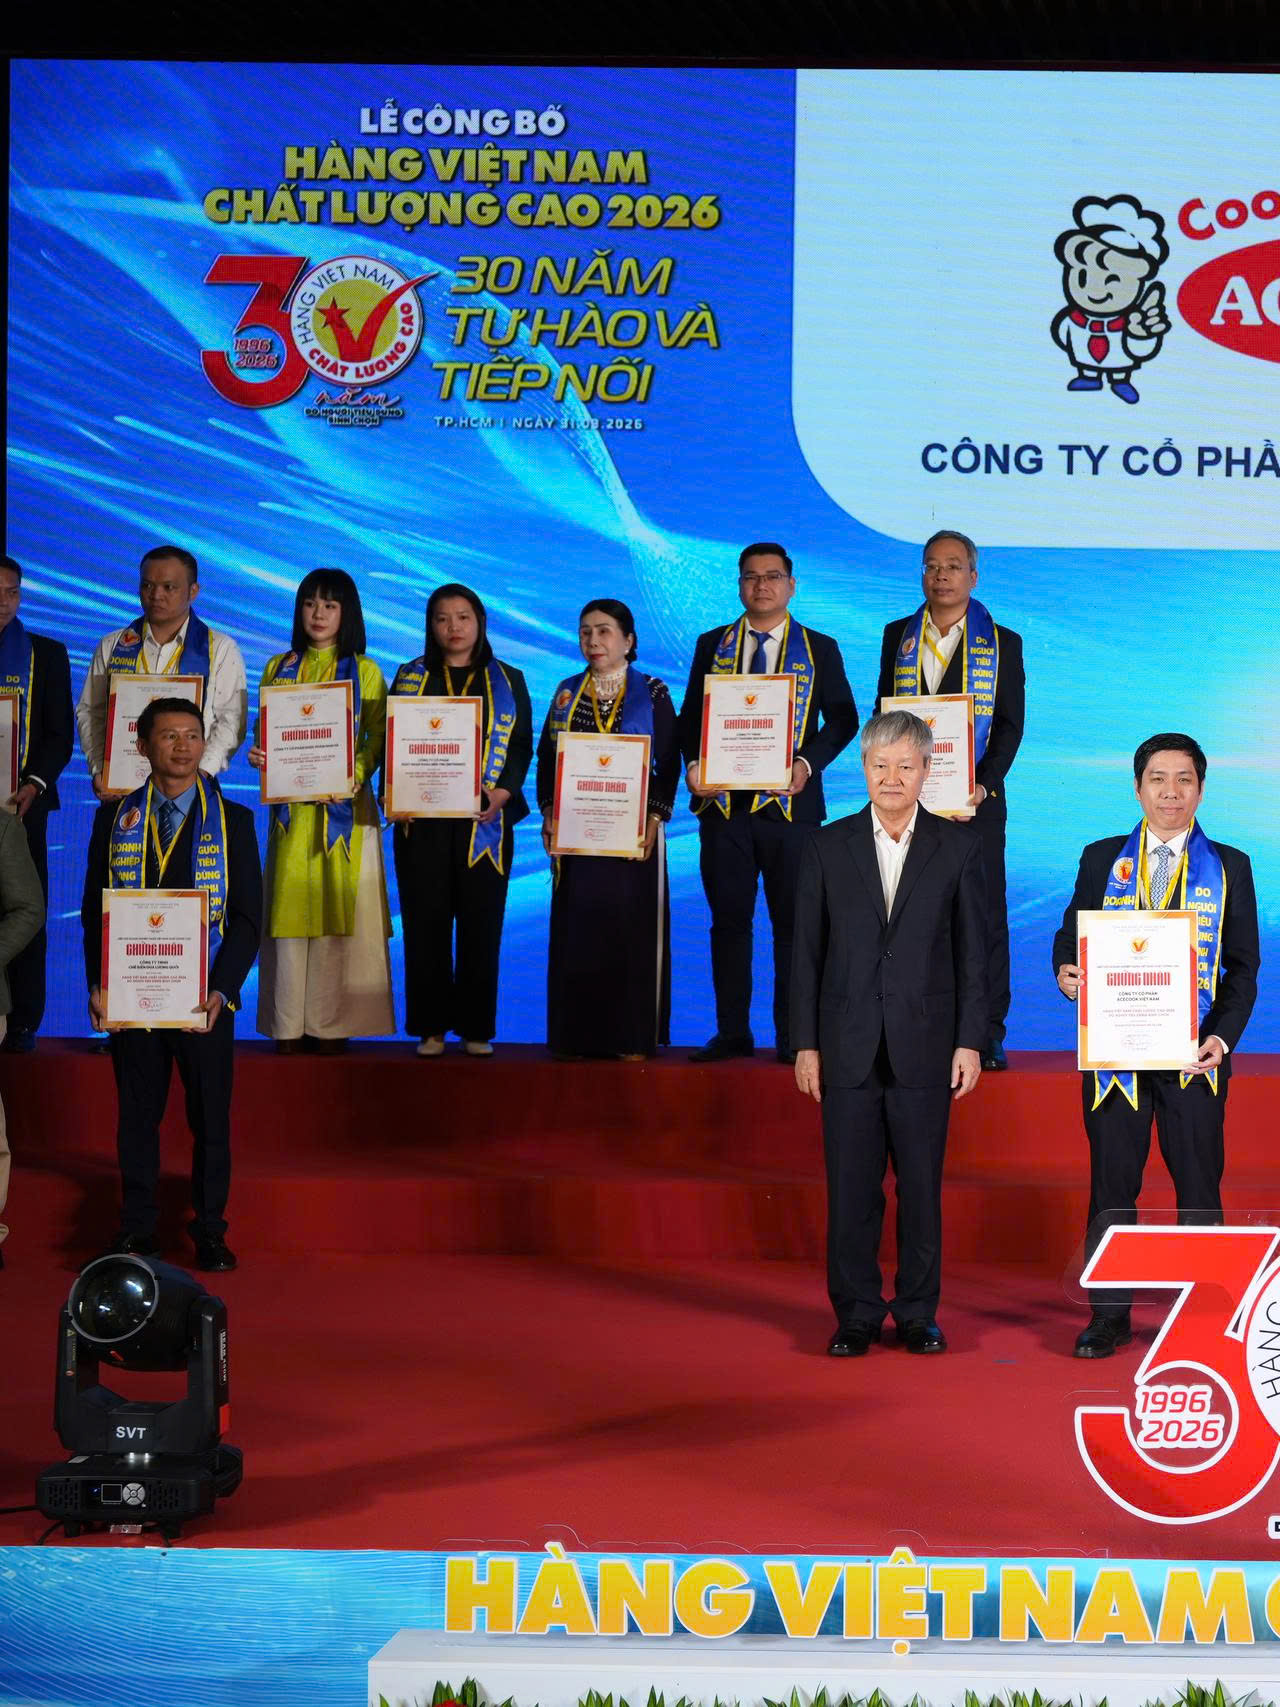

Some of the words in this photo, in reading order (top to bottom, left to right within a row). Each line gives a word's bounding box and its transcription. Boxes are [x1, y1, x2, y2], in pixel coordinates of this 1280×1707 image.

[360, 98, 398, 134] LỄ
[403, 103, 508, 135] CÔNG
[513, 104, 566, 136] BỐ
[284, 140, 425, 181] HÀNG
[427, 143, 528, 189] VIỆT
[533, 150, 648, 184] NAM
[203, 184, 324, 224] CHẤT
[329, 190, 505, 231] LƯỢNG
[505, 194, 605, 227] CAO
[606, 194, 722, 228] 2026
[353, 264, 395, 290] NAM
[451, 255, 524, 295] 30
[529, 248, 675, 296] NĂM
[400, 302, 416, 337] CAO
[445, 307, 529, 355] TỰ
[529, 302, 649, 348] HÀO
[655, 302, 720, 349] VÀ
[233, 338, 272, 352] 1996
[234, 353, 278, 369] 2026
[432, 354, 551, 402] TIẾP
[553, 355, 655, 403] NỐI
[512, 412, 555, 430] NGÀY
[920, 437, 1044, 478] CÔNG
[1058, 446, 1109, 477] TY
[1121, 437, 1183, 478] CỔ
[974, 705, 993, 716] 026
[1195, 886, 1211, 898] DO
[1198, 977, 1210, 990] 26
[1139, 1390, 1209, 1414] 1996
[115, 1426, 147, 1440] SVT
[1143, 1418, 1221, 1443] 2026
[443, 1542, 756, 1638] HÀNG
[762, 1547, 987, 1656] VIỆT
[1001, 1566, 1256, 1646] NAM
